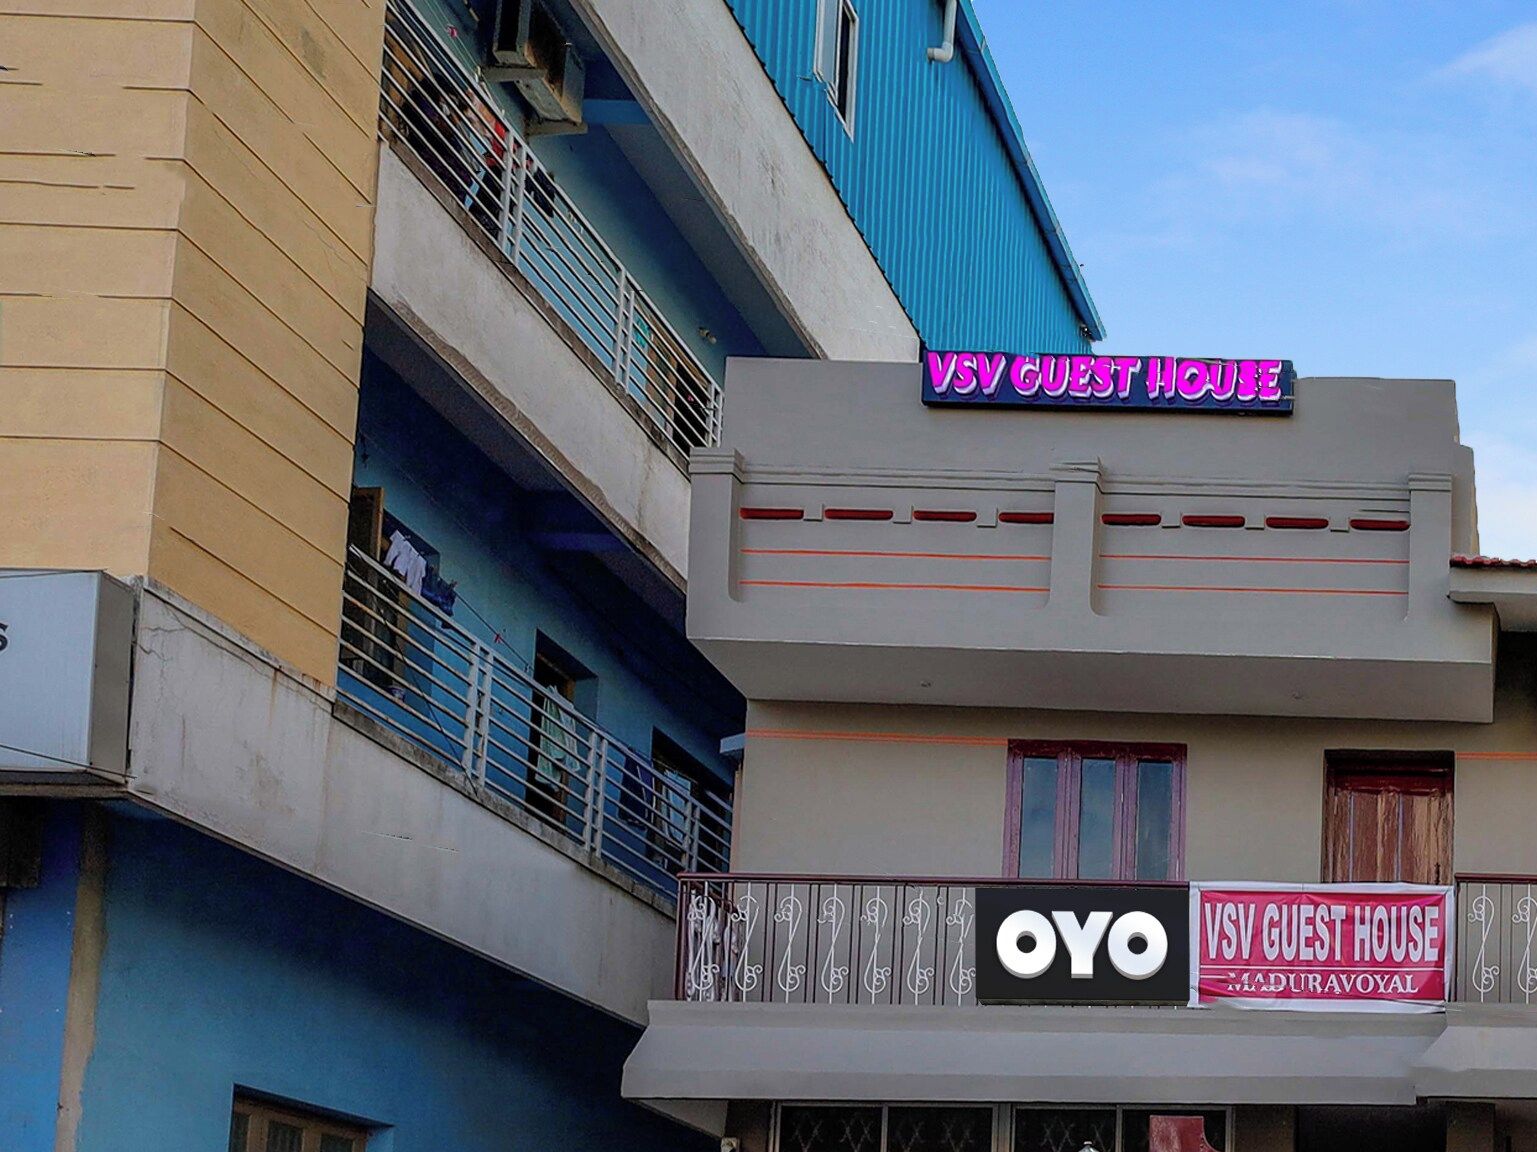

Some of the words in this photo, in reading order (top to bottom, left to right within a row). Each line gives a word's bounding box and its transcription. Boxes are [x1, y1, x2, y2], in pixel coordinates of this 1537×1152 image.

[927, 351, 1006, 395] VSV
[1010, 353, 1141, 400] GUEST
[1147, 356, 1282, 402] HOUSE
[996, 909, 1168, 981] OYO
[1204, 902, 1255, 960] VSV
[1262, 902, 1347, 962] GUEST
[1353, 905, 1439, 963] HOUSE
[1227, 972, 1419, 995] MADURAVOYAL
